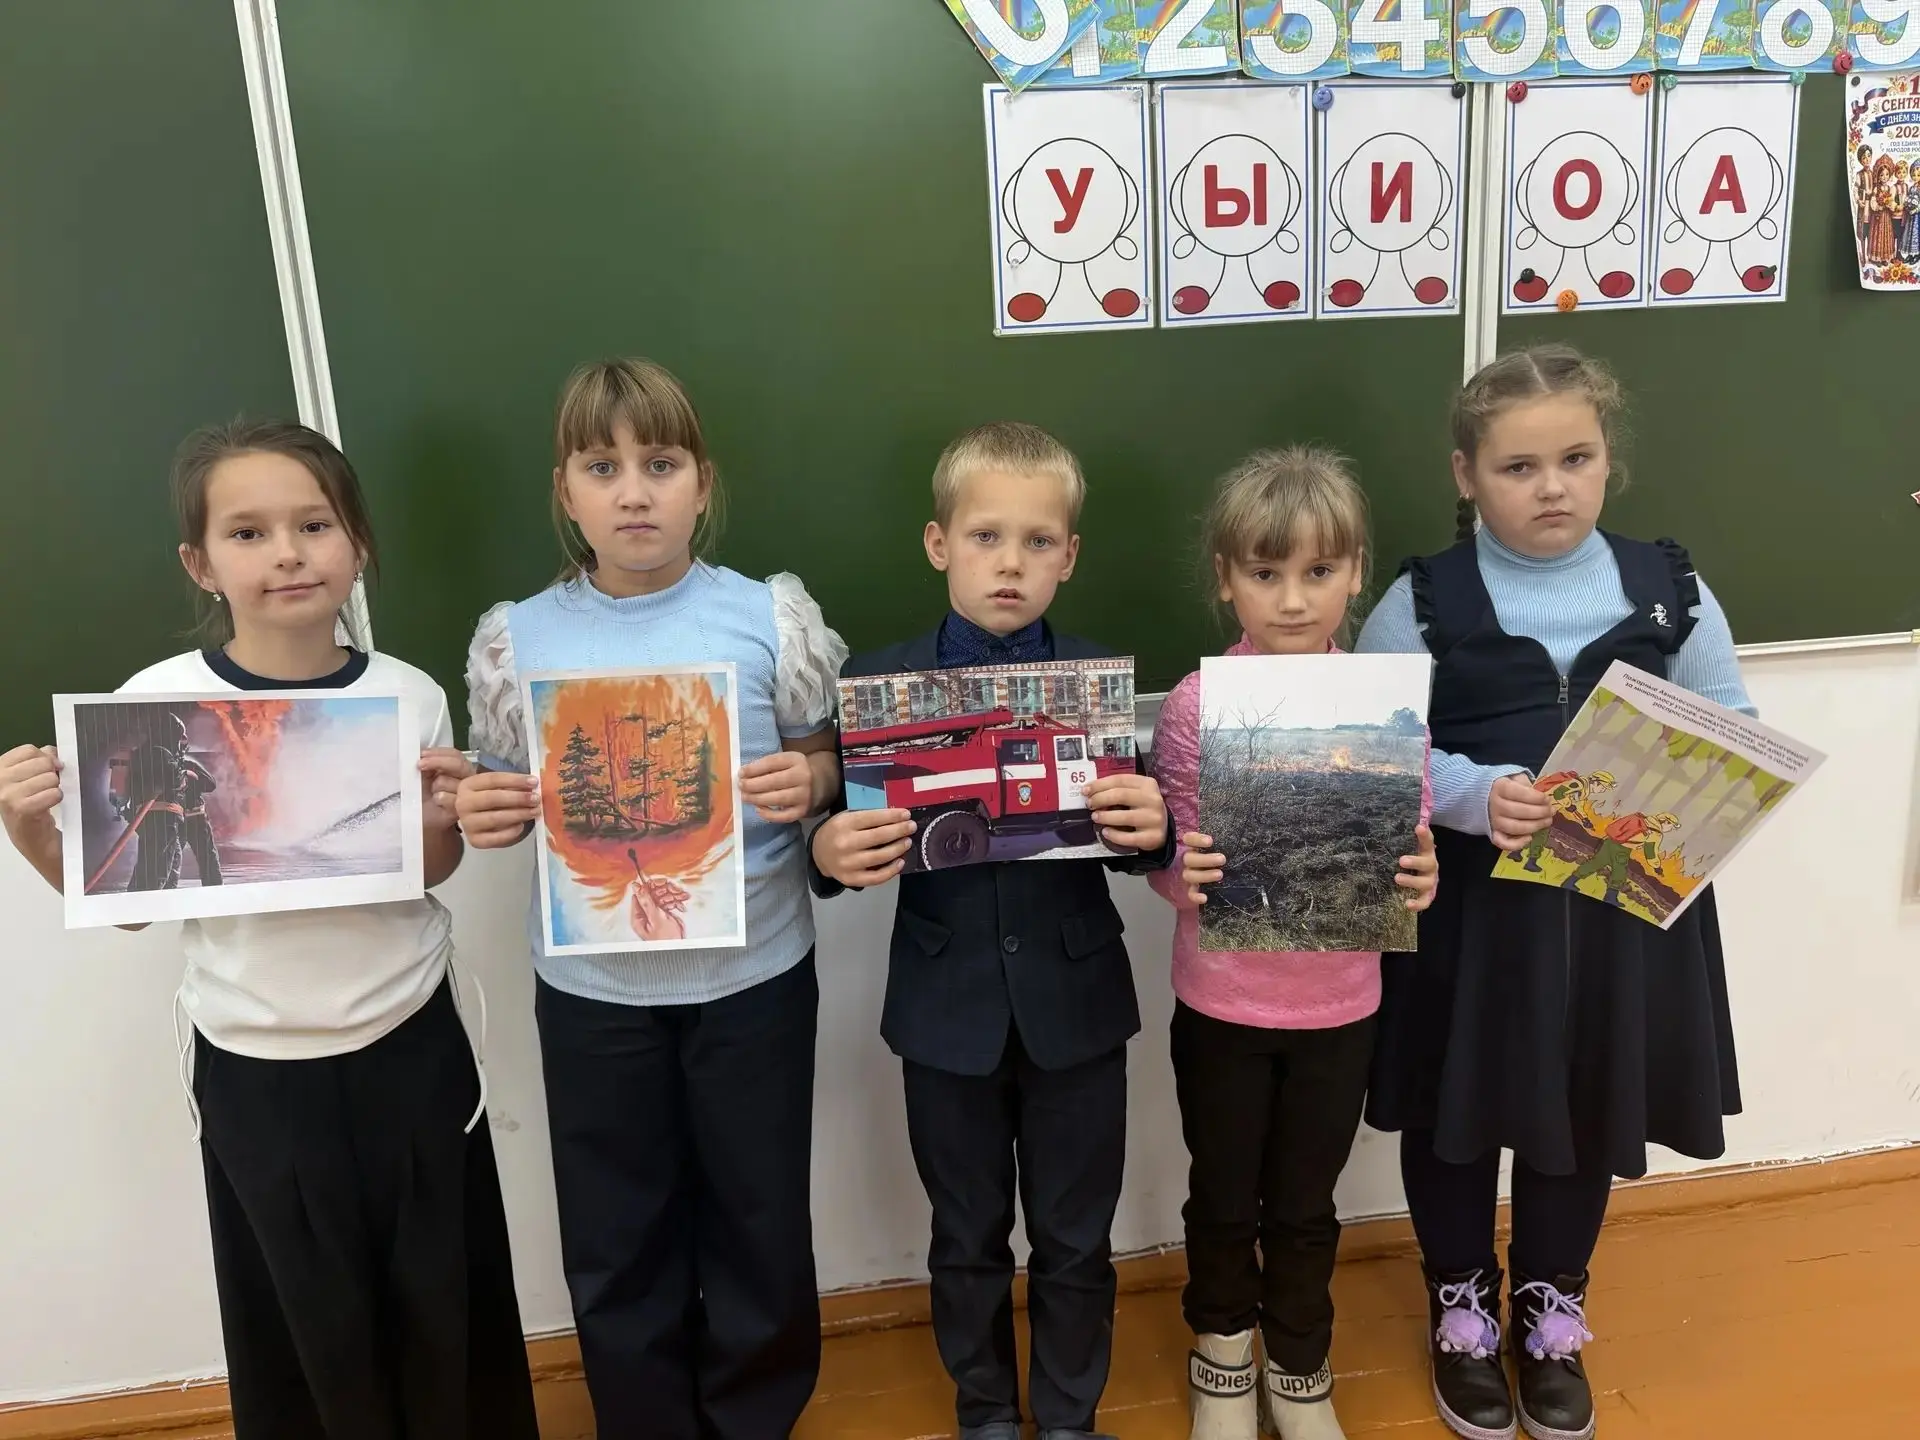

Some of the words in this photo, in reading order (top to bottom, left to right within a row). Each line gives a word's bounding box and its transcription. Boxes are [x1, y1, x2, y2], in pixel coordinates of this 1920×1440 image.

[1144, 0, 1230, 73] 2
[1249, 0, 1339, 76] 3
[1351, 0, 1441, 72] 4
[1462, 0, 1548, 76] 5
[1563, 0, 1646, 71] 6
[1880, 117, 1887, 126] С
[1045, 167, 1094, 234] У
[1203, 162, 1267, 228] Ы
[1370, 161, 1413, 223] И
[1552, 158, 1603, 220] О
[1699, 154, 1747, 215] А
[1622, 672, 1658, 692] Пожарные
[1071, 771, 1086, 783] 65
[1197, 1363, 1252, 1389] uppies
